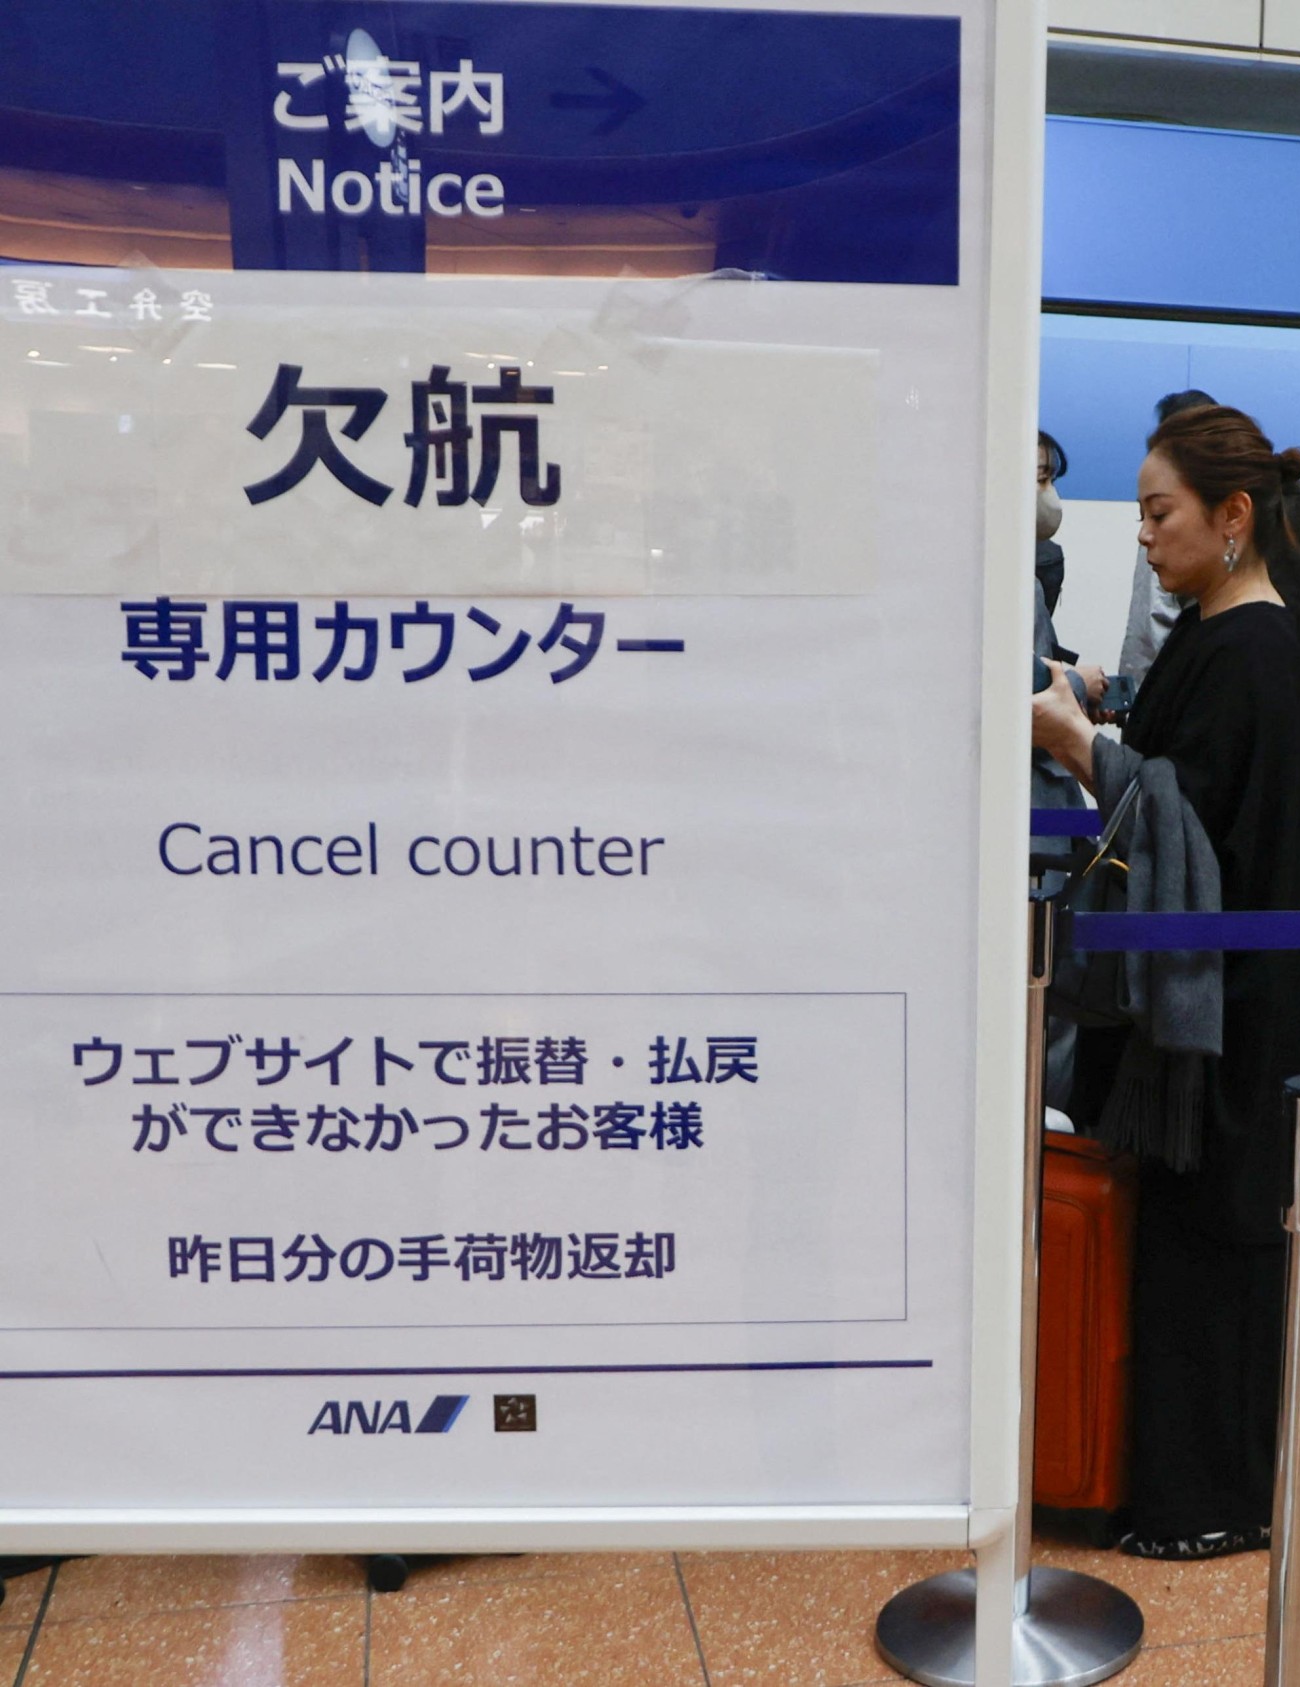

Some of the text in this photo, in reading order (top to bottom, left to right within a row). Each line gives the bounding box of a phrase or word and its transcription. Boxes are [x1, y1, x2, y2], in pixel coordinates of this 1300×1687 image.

[275, 57, 504, 136] ご案内
[279, 159, 504, 217] Notice
[244, 364, 560, 508] 欠航
[121, 597, 684, 684] 専用カウンター
[159, 822, 665, 877] Cancel counter
[74, 1034, 759, 1087] ウェブサイトで振替・払戻
[133, 1101, 704, 1153] ができなかったお客様
[169, 1232, 676, 1284] 昨日分の手荷物返却
[308, 1401, 412, 1435] ANA
